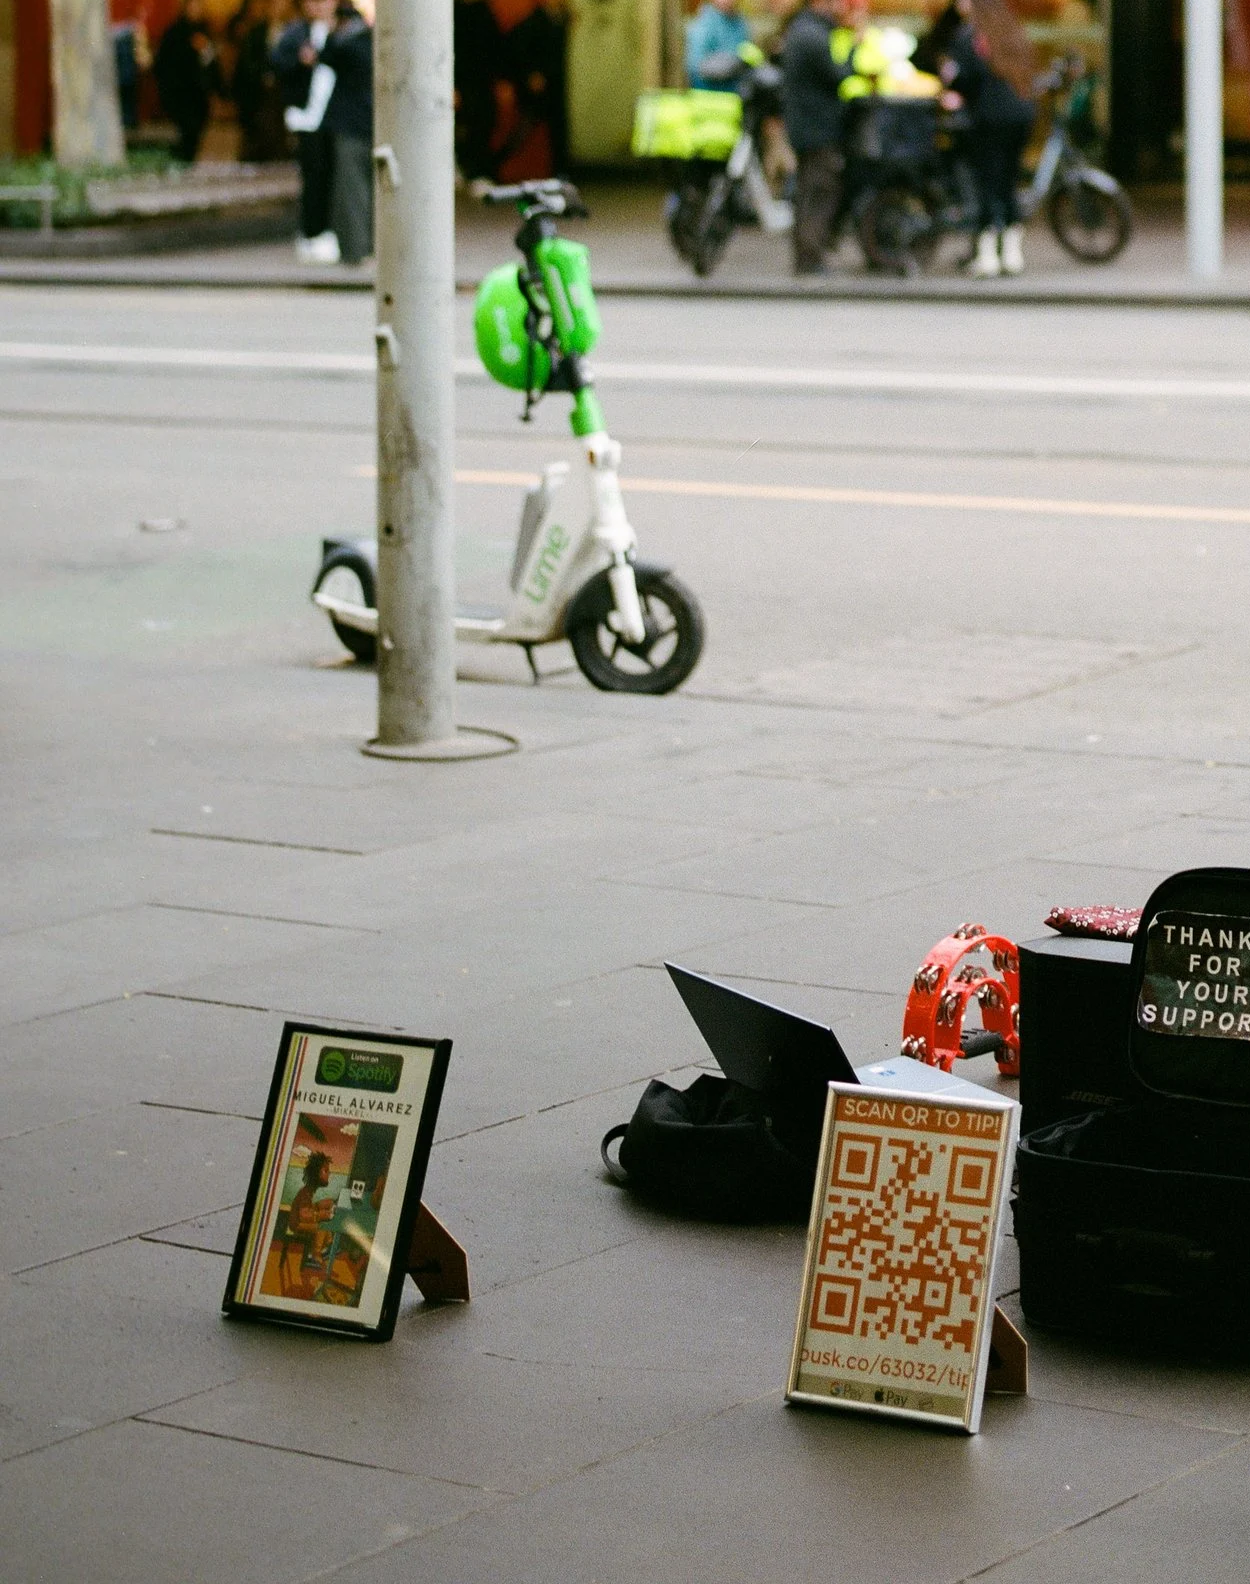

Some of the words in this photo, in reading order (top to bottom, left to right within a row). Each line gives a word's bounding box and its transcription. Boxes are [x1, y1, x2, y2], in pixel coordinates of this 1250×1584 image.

[1188, 954, 1240, 976] FOR
[1176, 980, 1249, 1005] YOUR
[347, 1063, 397, 1085] Spotify
[293, 1090, 342, 1107] MIGUEL
[350, 1097, 413, 1115] ALVAREZ
[844, 1098, 896, 1120] SCAN
[902, 1105, 928, 1126] QR
[935, 1109, 960, 1128] TO
[967, 1112, 1000, 1133] TIP!
[886, 1388, 909, 1407] Pay
